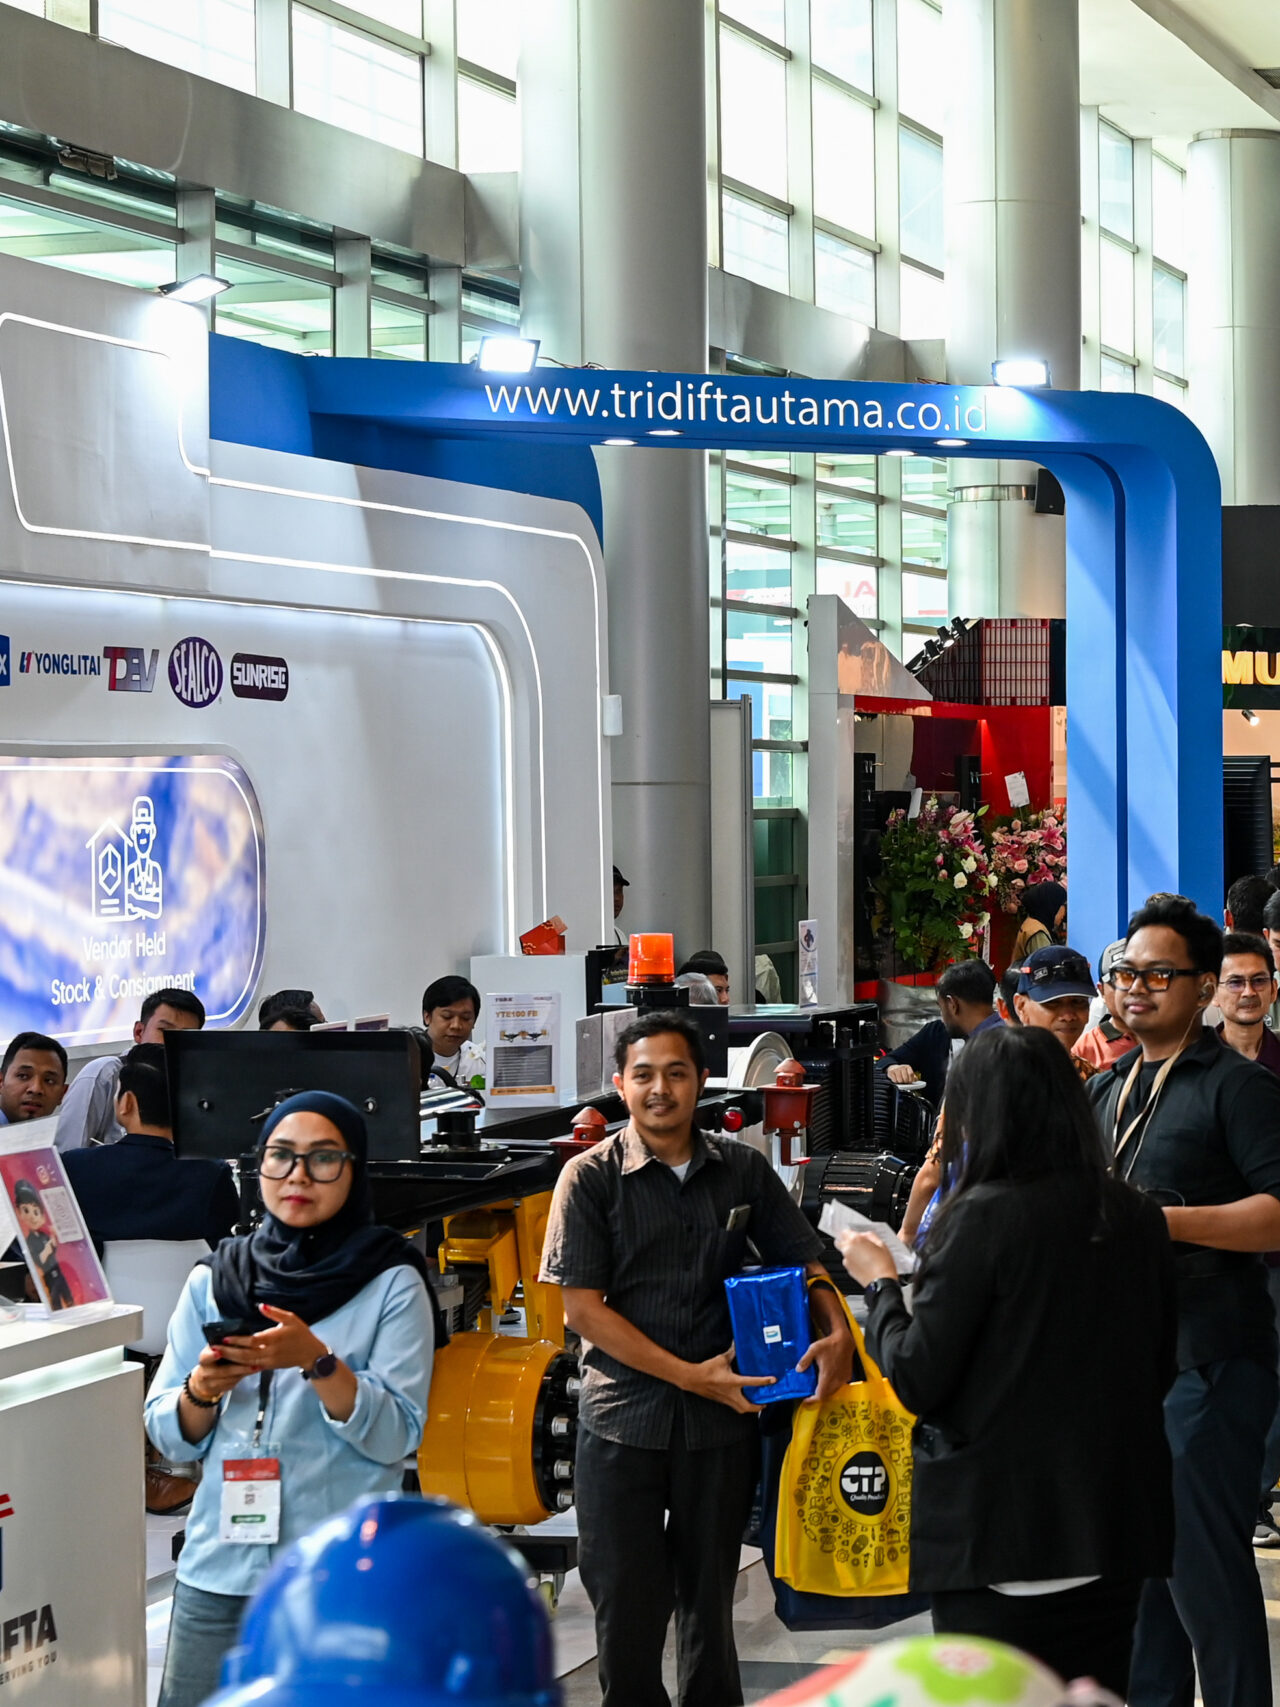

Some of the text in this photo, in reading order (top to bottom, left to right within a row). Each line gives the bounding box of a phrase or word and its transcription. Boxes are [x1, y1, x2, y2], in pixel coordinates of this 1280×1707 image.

[485, 380, 988, 433] www.tridiftautama.co.id
[35, 652, 101, 676] YONGLITAI
[174, 641, 220, 703] SEALCO
[233, 662, 287, 690] SUNRISE
[83, 931, 166, 961] Vendor Held
[51, 977, 90, 1005] Stock
[94, 974, 104, 999] &
[0, 1603, 58, 1665] FTA
